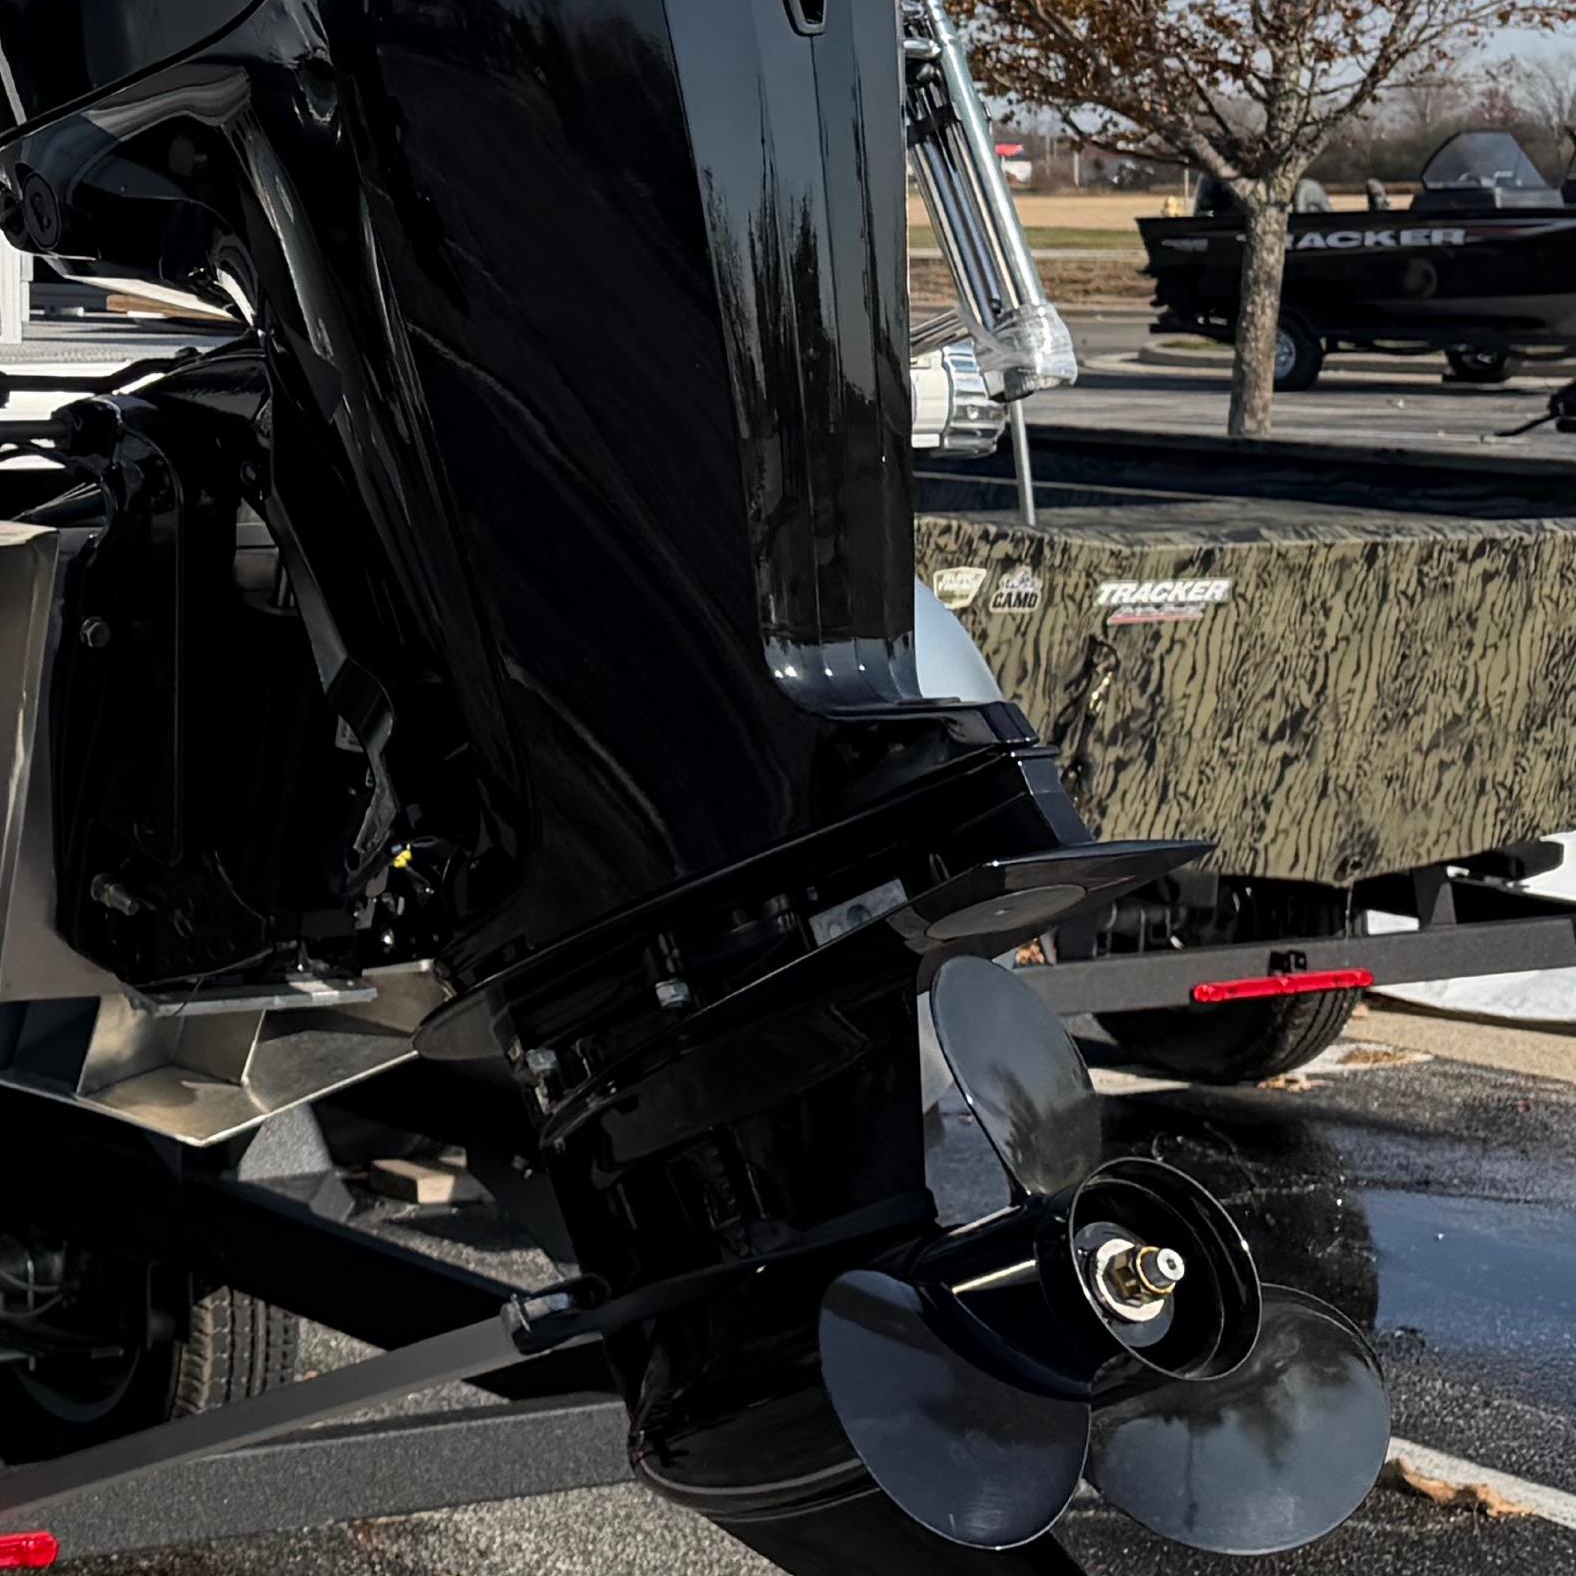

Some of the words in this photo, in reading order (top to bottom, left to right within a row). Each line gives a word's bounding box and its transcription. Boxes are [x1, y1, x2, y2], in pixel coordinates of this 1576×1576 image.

[1236, 228, 1466, 250] ACKER
[991, 591, 1039, 609] CAMO
[1097, 579, 1230, 605] TRACKER
